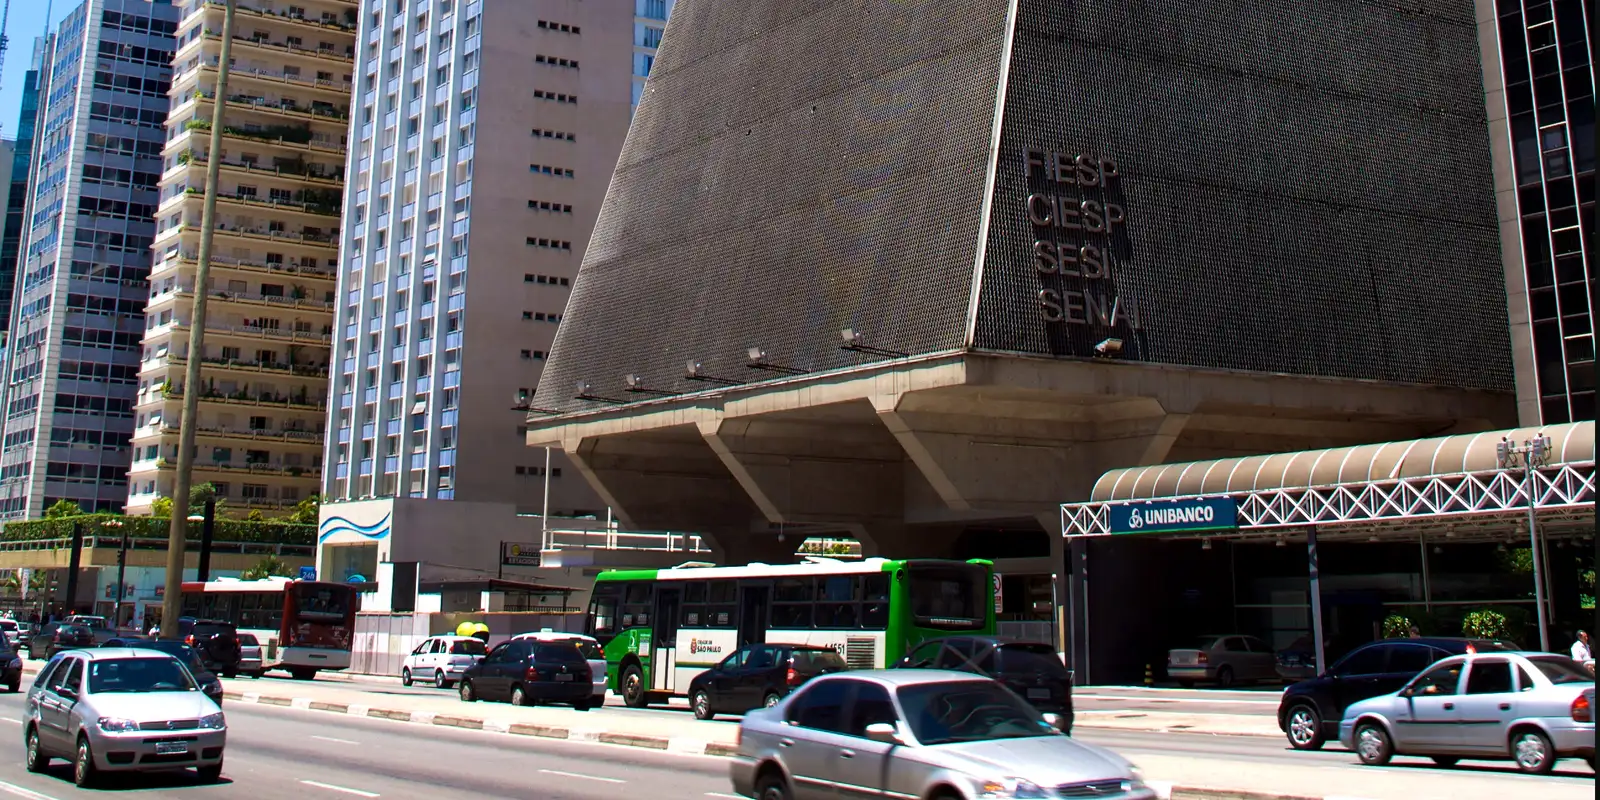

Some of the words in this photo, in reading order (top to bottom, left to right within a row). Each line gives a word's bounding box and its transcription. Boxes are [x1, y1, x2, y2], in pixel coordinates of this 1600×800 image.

[1023, 147, 1118, 188] FIESP
[1028, 193, 1124, 233] CIESP
[1035, 240, 1110, 279] SESI
[1040, 288, 1141, 329] SENAI
[1145, 506, 1214, 525] UNIBANCO
[303, 571, 315, 579] 24h
